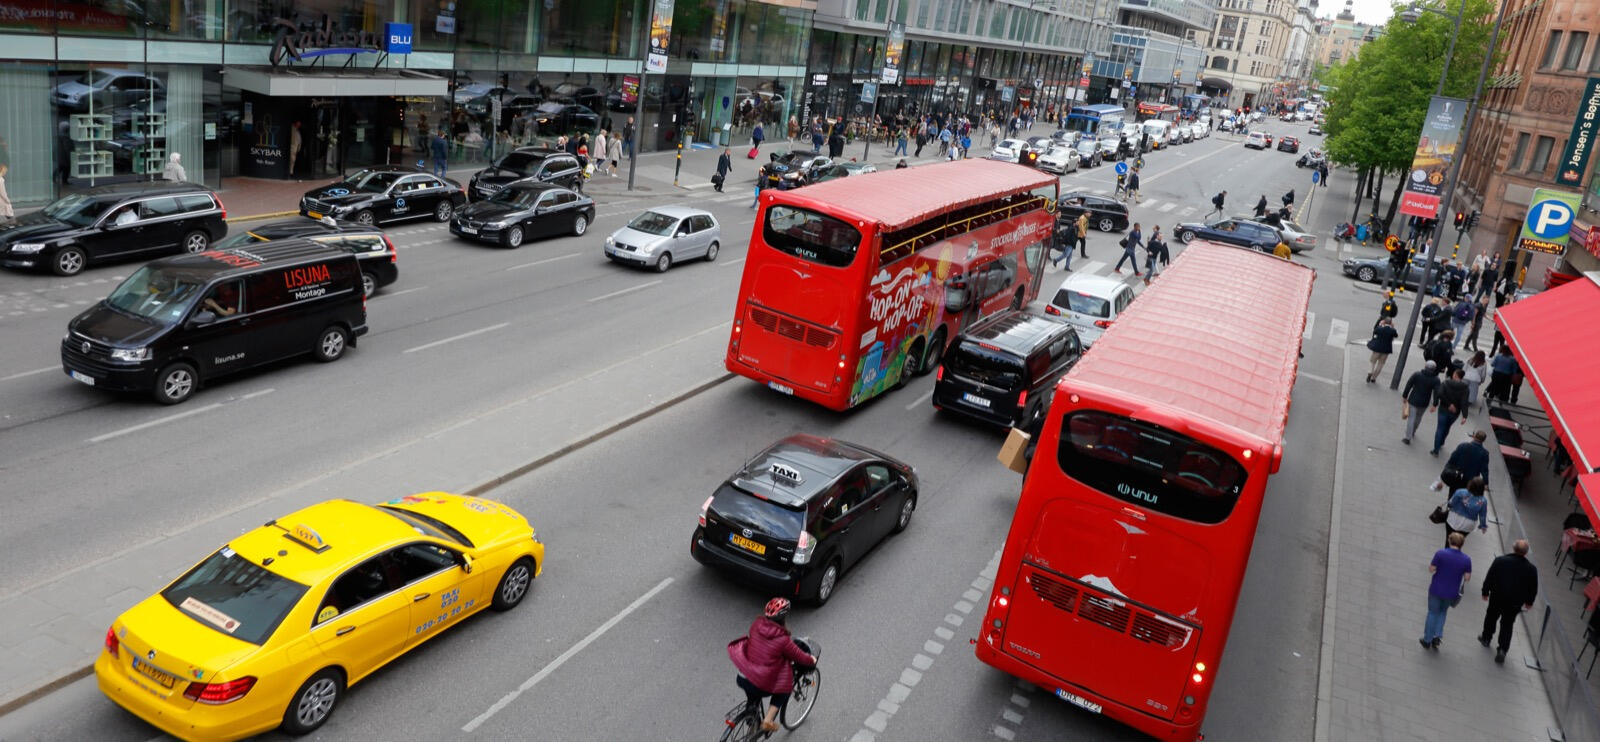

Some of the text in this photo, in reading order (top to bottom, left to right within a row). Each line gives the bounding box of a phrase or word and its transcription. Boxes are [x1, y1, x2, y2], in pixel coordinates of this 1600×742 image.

[390, 35, 412, 45] BLU
[250, 147, 282, 158] SKYBAR
[1534, 203, 1571, 235] P
[283, 264, 331, 289] LISUNA
[294, 287, 327, 300] Montage
[869, 279, 912, 322] HOP-ON
[882, 295, 925, 334] HOP-OFF
[214, 352, 246, 365] lisuna.se
[771, 463, 798, 480] TAXI
